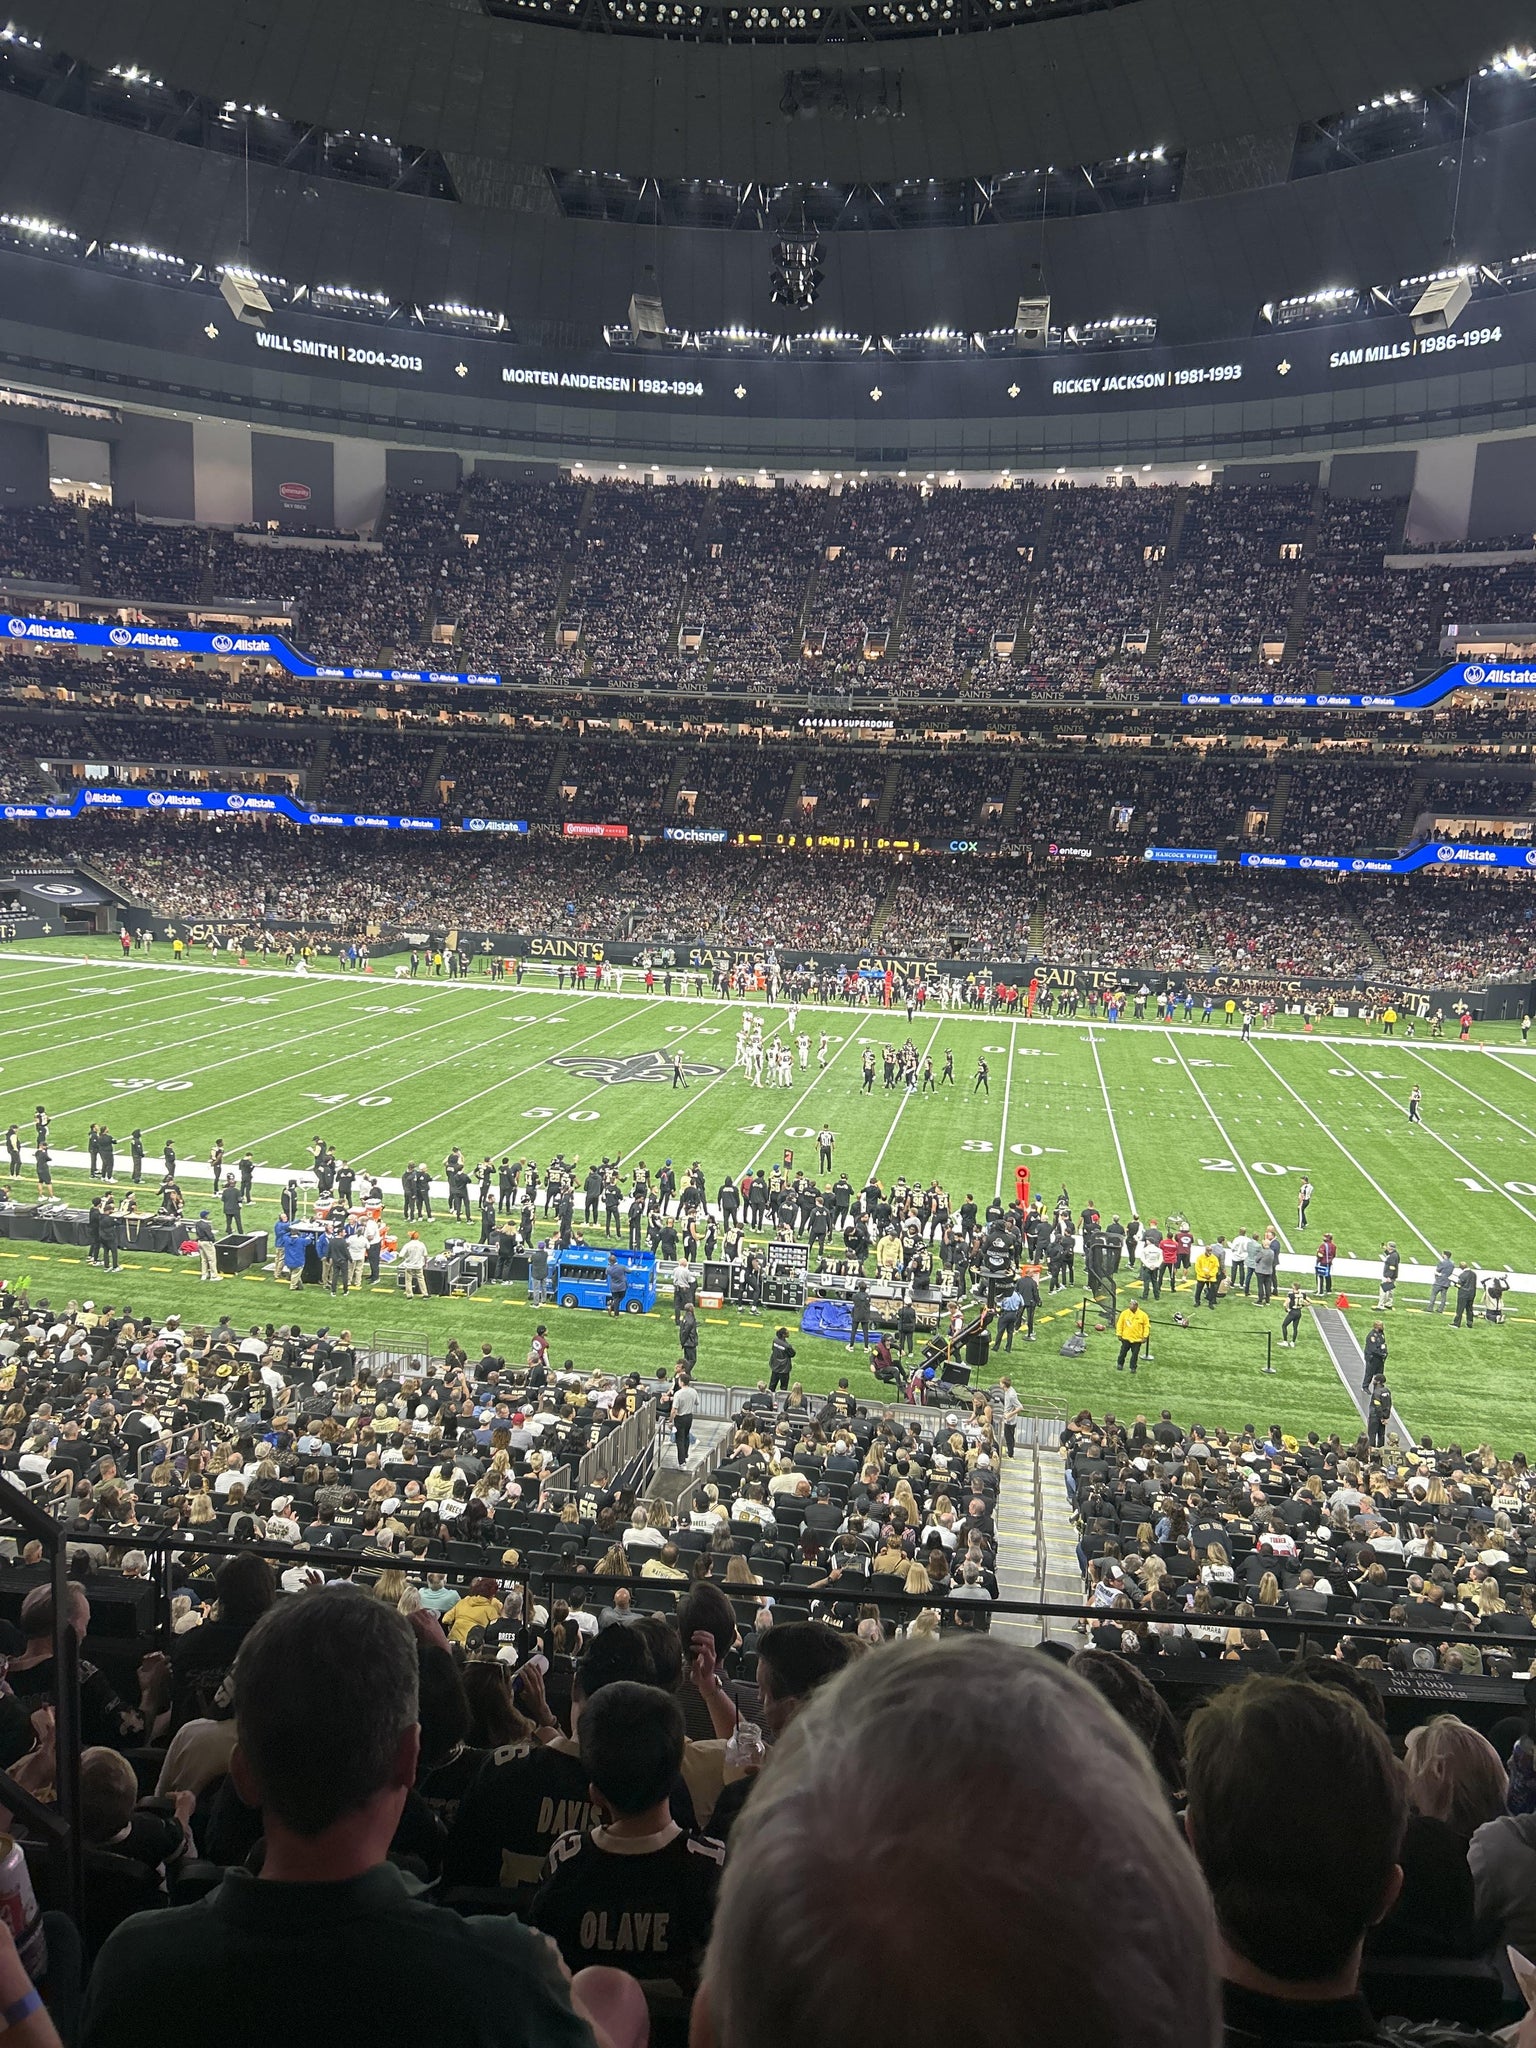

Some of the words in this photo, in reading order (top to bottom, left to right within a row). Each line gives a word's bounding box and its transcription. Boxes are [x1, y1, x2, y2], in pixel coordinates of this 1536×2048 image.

[256, 332, 292, 353] WILL
[293, 339, 339, 359] SMITH
[347, 348, 422, 371] 2004-2013
[1330, 348, 1363, 367] SAM
[1364, 342, 1411, 363] MILLS
[1419, 326, 1502, 353] 1986-1994
[502, 368, 558, 385] MORTEN
[560, 373, 630, 392] ANDERSEN
[638, 379, 703, 396] 1982-1994
[1053, 377, 1101, 394] RICKEY
[1102, 372, 1165, 391] JACKSON
[1174, 364, 1242, 385] 1981-1993
[26, 624, 75, 640] Allstate
[132, 632, 180, 647] Allstate
[233, 638, 270, 652] Allstate
[9, 675, 41, 685] SAINTS
[538, 677, 569, 686] SAINTS
[608, 680, 639, 688] SAINTS
[80, 681, 112, 692] SAINTS
[150, 686, 182, 696] SAINTS
[677, 682, 708, 692] SAINTS
[747, 685, 778, 694] SAINTS
[221, 692, 253, 701] SAINTS
[888, 689, 920, 698] SAINTS
[959, 690, 991, 699] SAINTS
[1031, 691, 1064, 700] SAINTS
[1105, 693, 1139, 701] SAINTS
[290, 695, 320, 705] SAINTS
[358, 698, 388, 708] SAINTS
[423, 702, 452, 711] SAINTS
[488, 706, 518, 715] SAINTS
[552, 709, 581, 718] SAINTS
[616, 711, 645, 720] SAINTS
[680, 714, 708, 722] SAINTS
[744, 716, 772, 725] SAINTS
[798, 717, 843, 728] CAESARS
[843, 719, 894, 728] SUPERDOME
[164, 795, 201, 806] Allstate
[243, 798, 275, 808] Allstate
[485, 820, 519, 832] Allstate
[530, 822, 560, 832] SAINTS
[566, 823, 604, 835] Community
[674, 829, 725, 842] Ochsner
[949, 840, 977, 852] COX
[1000, 843, 1032, 853] SAINTS
[1059, 847, 1092, 858] entergy
[1155, 851, 1184, 859] HANCOCK
[1186, 853, 1217, 861] WHITNEY
[1454, 848, 1496, 861] Allstate
[530, 938, 604, 958] SAINTS
[626, 1395, 636, 1412] 9
[579, 1498, 598, 1518] 56
[334, 1516, 353, 1525] KAMARA
[498, 1632, 516, 1642] BREES
[1390, 1669, 1444, 1681] PLEASE
[1391, 1678, 1411, 1688] NO
[1416, 1679, 1454, 1691] FOOD
[1388, 1687, 1408, 1695] OR
[1413, 1688, 1468, 1699] DRINKS
[537, 1796, 603, 1836] DAVIS
[580, 1911, 670, 1953] OLAVE
